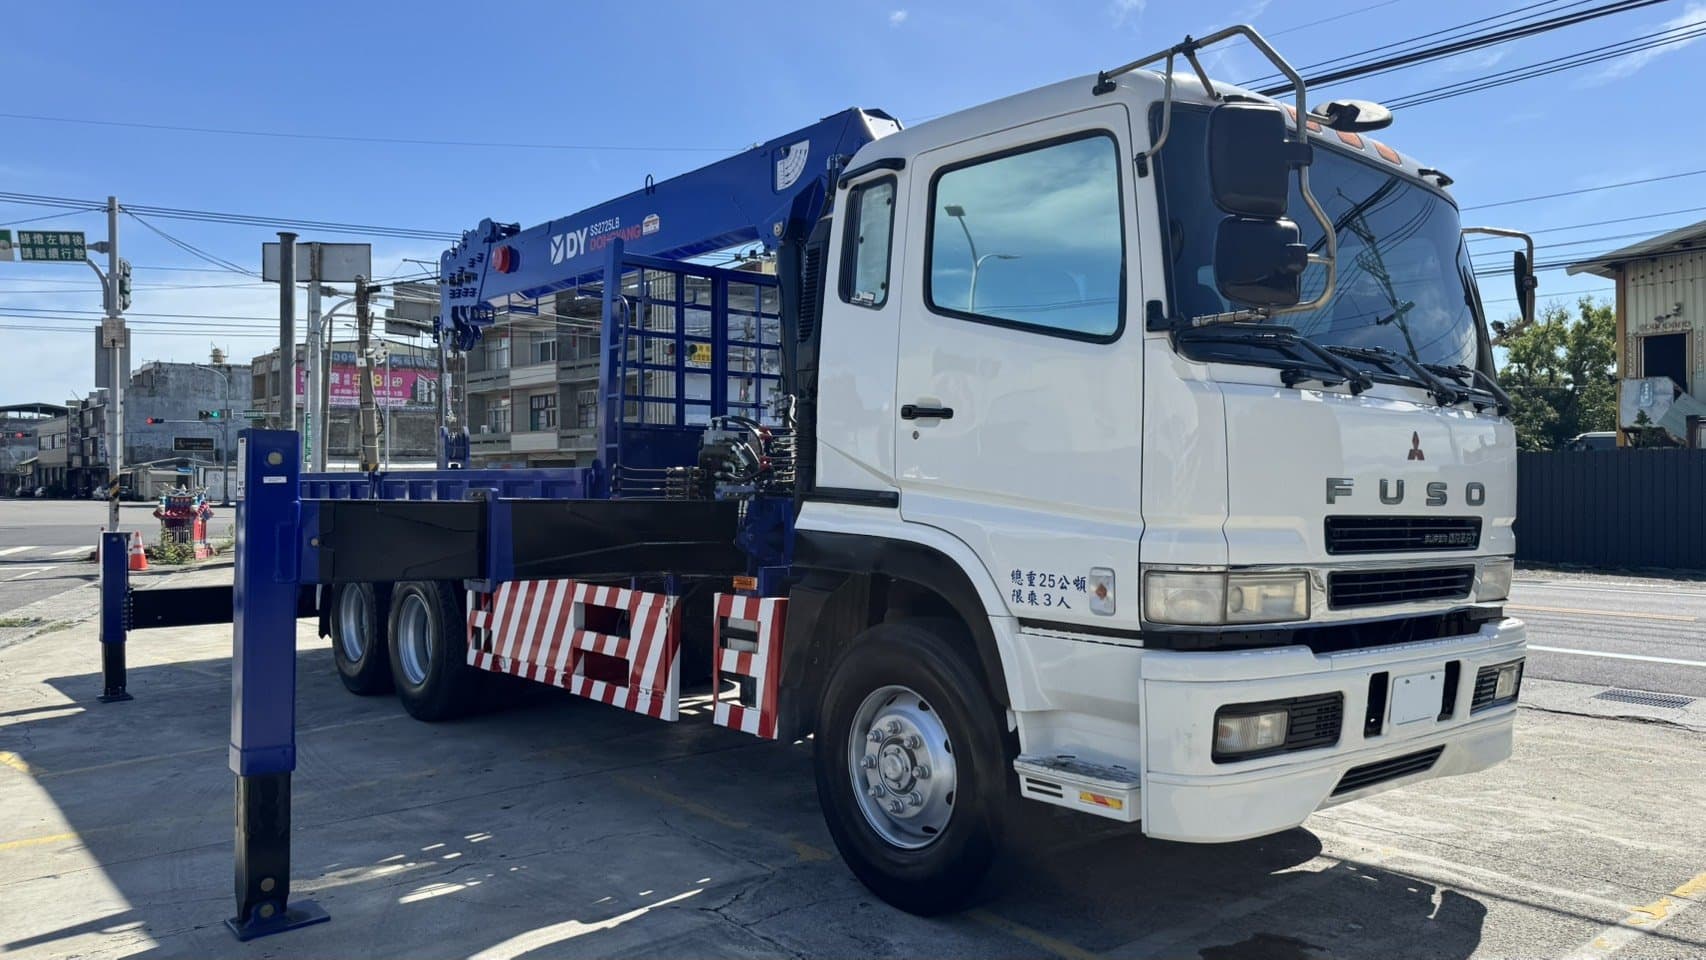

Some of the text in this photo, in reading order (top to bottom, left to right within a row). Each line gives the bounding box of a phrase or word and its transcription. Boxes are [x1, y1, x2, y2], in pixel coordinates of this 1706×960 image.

[590, 217, 620, 236] SS2725LB
[566, 228, 588, 259] DY
[1326, 477, 1485, 507] FUSO
